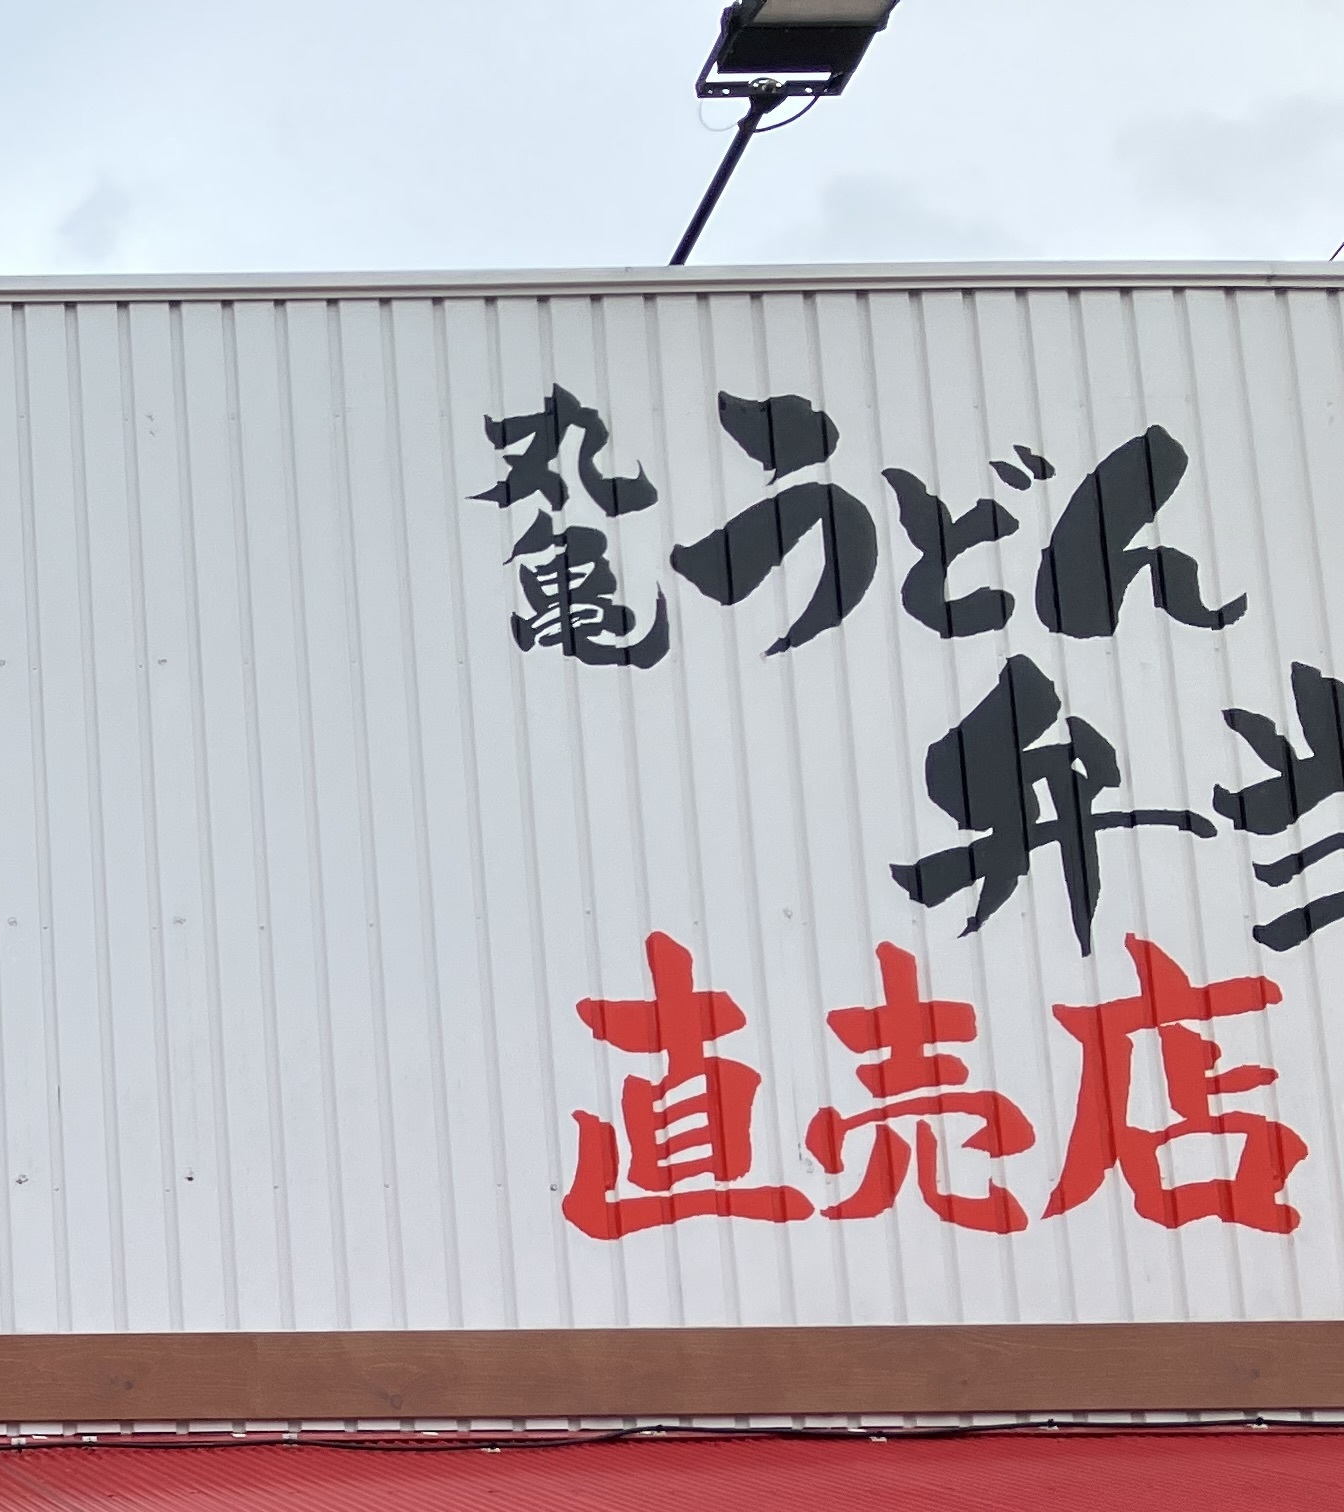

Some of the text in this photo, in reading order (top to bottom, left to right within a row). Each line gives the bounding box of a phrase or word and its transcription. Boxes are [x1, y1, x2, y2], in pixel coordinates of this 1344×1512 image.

[466, 383, 671, 669] 丸亀
[670, 390, 1248, 658] うどん
[562, 930, 1309, 1240] 直売店
